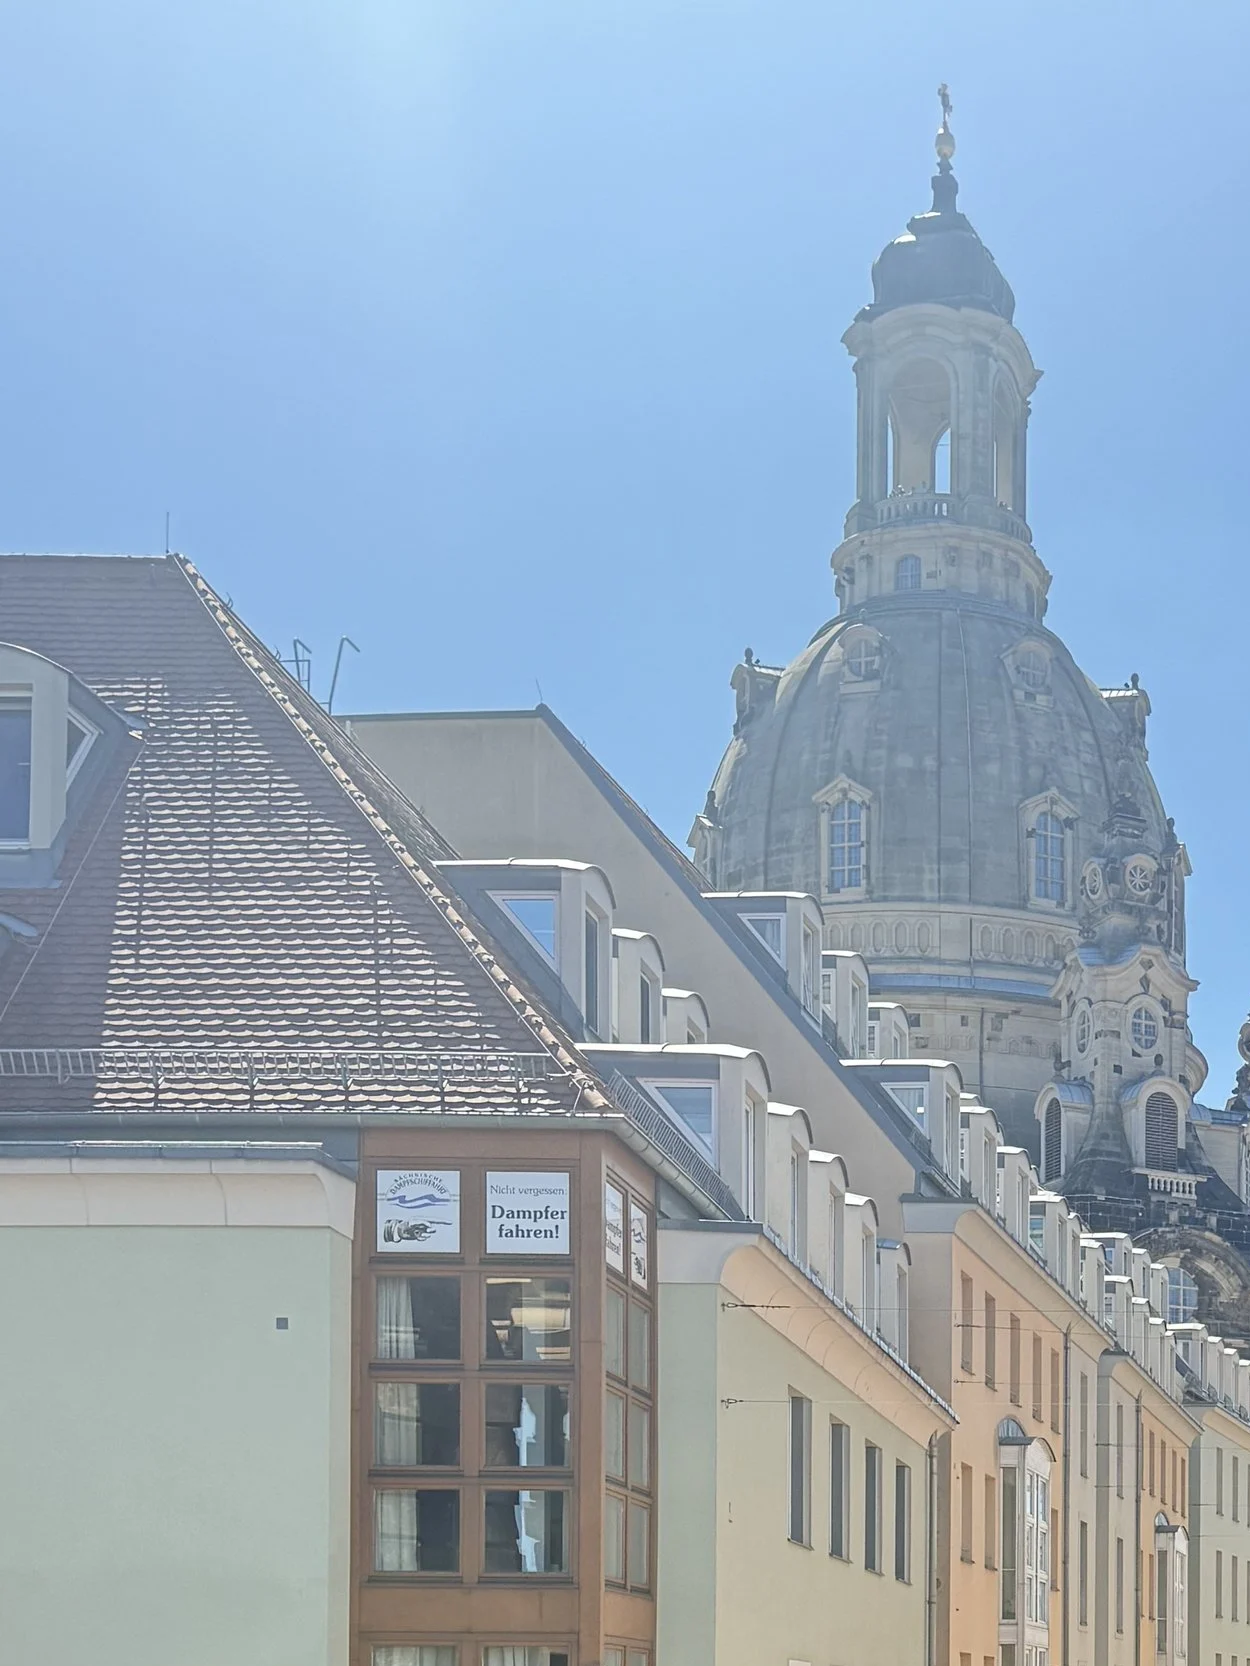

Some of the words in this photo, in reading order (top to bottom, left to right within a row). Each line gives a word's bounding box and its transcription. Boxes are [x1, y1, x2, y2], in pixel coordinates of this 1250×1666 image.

[490, 1185, 515, 1195] Nicht
[518, 1187, 568, 1197] vergessen:
[491, 1205, 567, 1222] Dampfer
[499, 1224, 559, 1239] fahren!
